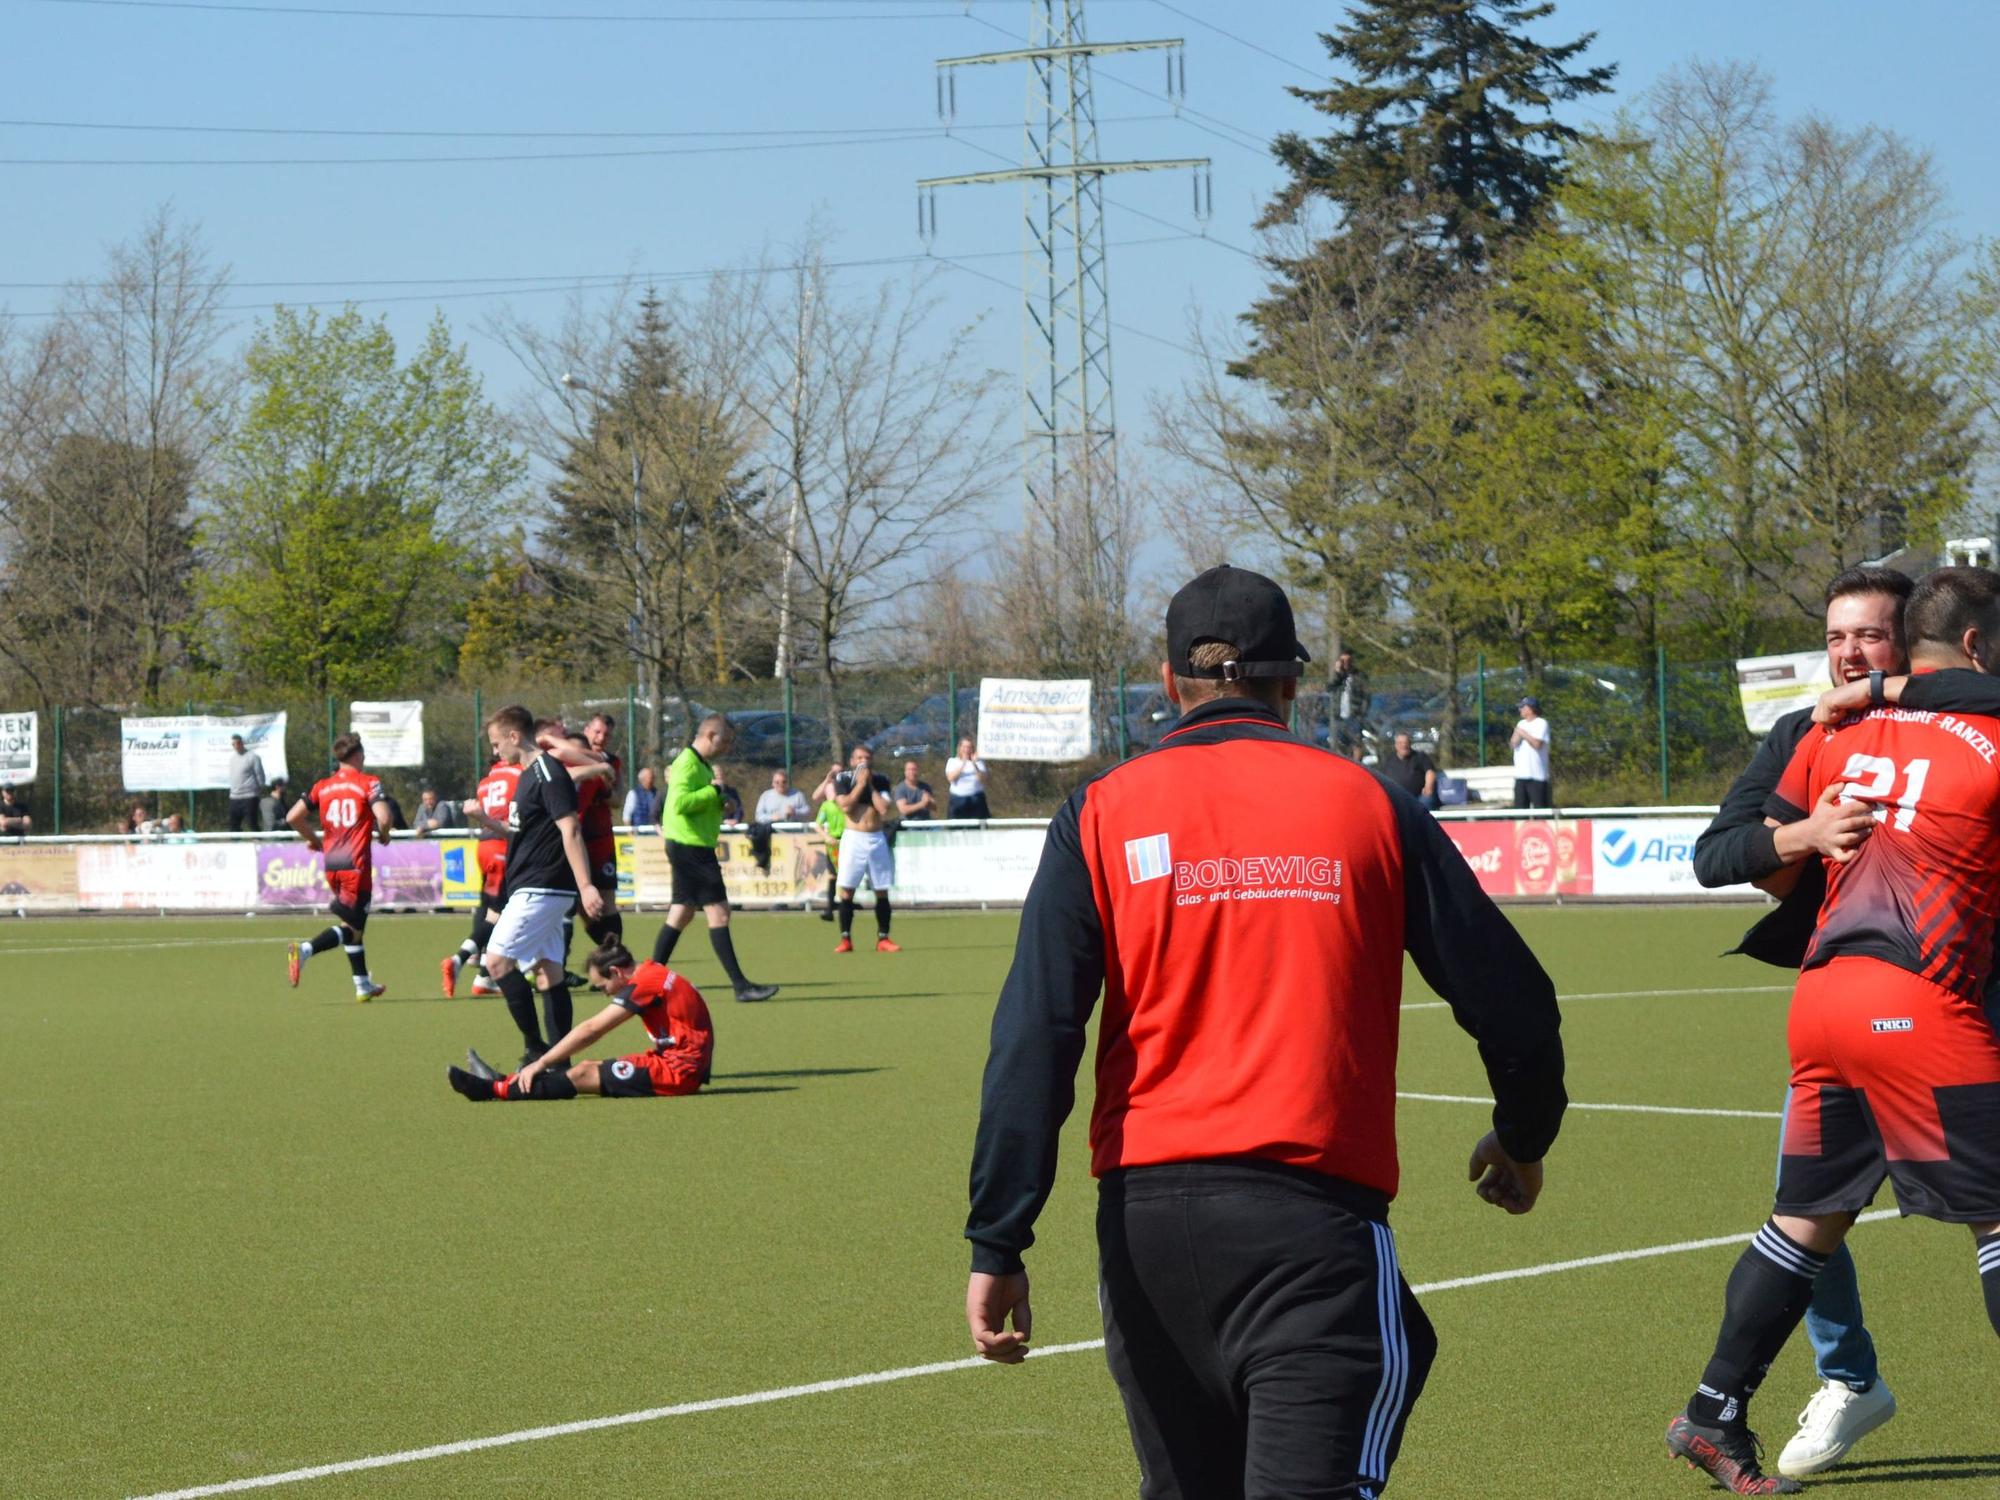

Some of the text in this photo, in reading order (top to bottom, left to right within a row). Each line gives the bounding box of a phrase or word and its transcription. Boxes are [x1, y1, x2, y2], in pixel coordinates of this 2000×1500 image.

[1839, 753, 1931, 832] 21
[325, 798, 358, 829] 40
[1174, 856, 1342, 891] BODEWIG GmbH
[753, 881, 788, 897] 1332
[1176, 886, 1341, 906] Glas- und Gebäudereinigung
[1873, 1019, 1911, 1031] TNKD
